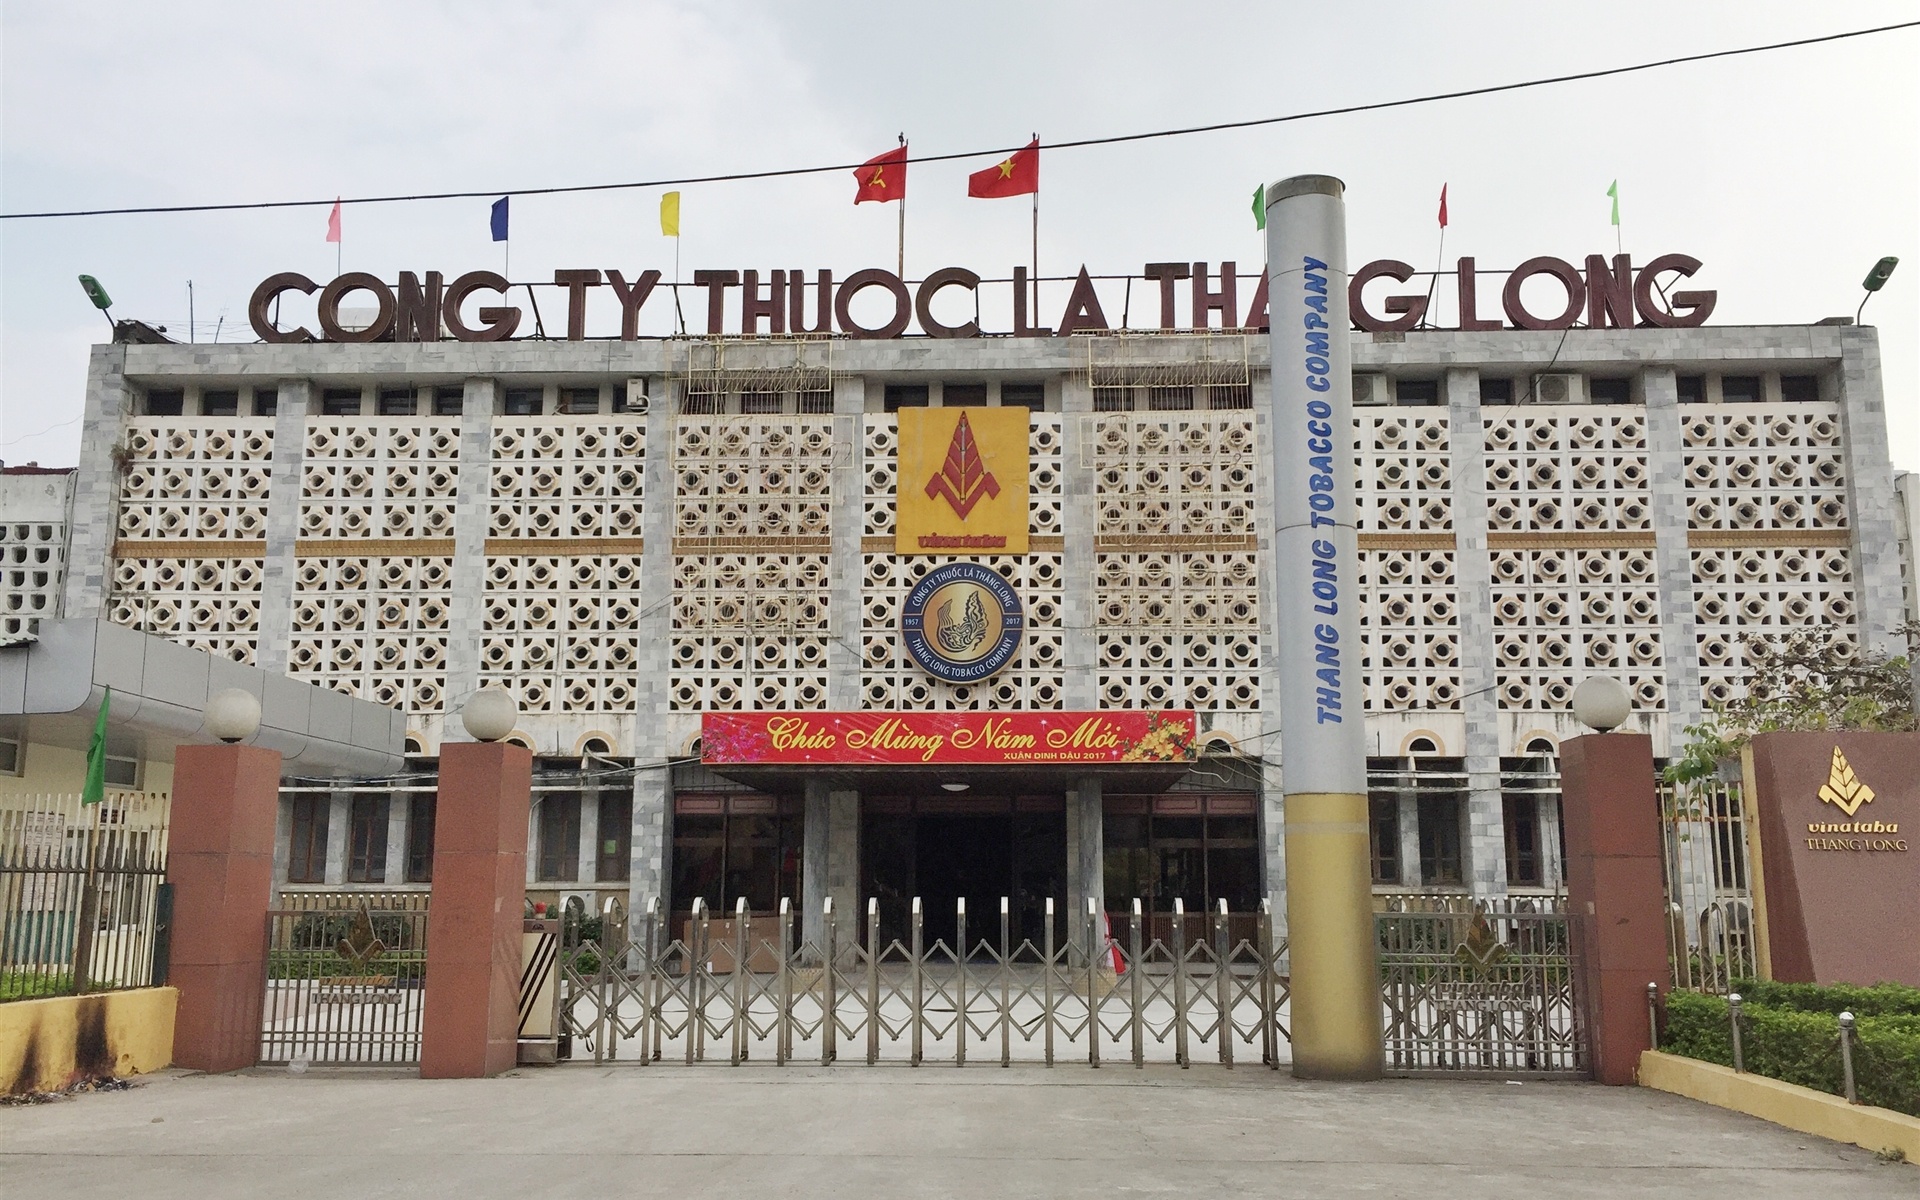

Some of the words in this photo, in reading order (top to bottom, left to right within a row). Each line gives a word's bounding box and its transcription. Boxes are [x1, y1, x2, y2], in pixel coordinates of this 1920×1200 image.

[248, 271, 522, 343] CONG
[555, 269, 662, 342] TY
[694, 268, 981, 340] THUOC
[1013, 263, 1110, 338] LA
[1144, 259, 1428, 334] THAG
[1457, 253, 1717, 330] LONG
[1303, 255, 1331, 392] COMPANY
[1307, 400, 1336, 529] TOBACCO
[926, 579, 937, 589] TY
[964, 567, 974, 577] LÁ
[997, 586, 1014, 607] LONG
[1311, 539, 1338, 616] LONG
[905, 618, 919, 626] 1957
[1006, 617, 1020, 625] 2017
[912, 638, 930, 663] THANG
[929, 659, 950, 675] LONG
[951, 664, 985, 677] TOBACCO
[985, 637, 1013, 669] COMPANY
[1314, 623, 1342, 725] THANG
[767, 716, 836, 752] Chúc
[846, 718, 944, 761] Mừng
[951, 717, 1037, 749] Năm
[1046, 717, 1122, 749] Mới
[1003, 751, 1032, 760] XUÂN
[1083, 752, 1106, 760] 2017
[1804, 838, 1861, 851] THANG
[1863, 839, 1908, 852] LONG
[1807, 821, 1899, 834] vinataba
